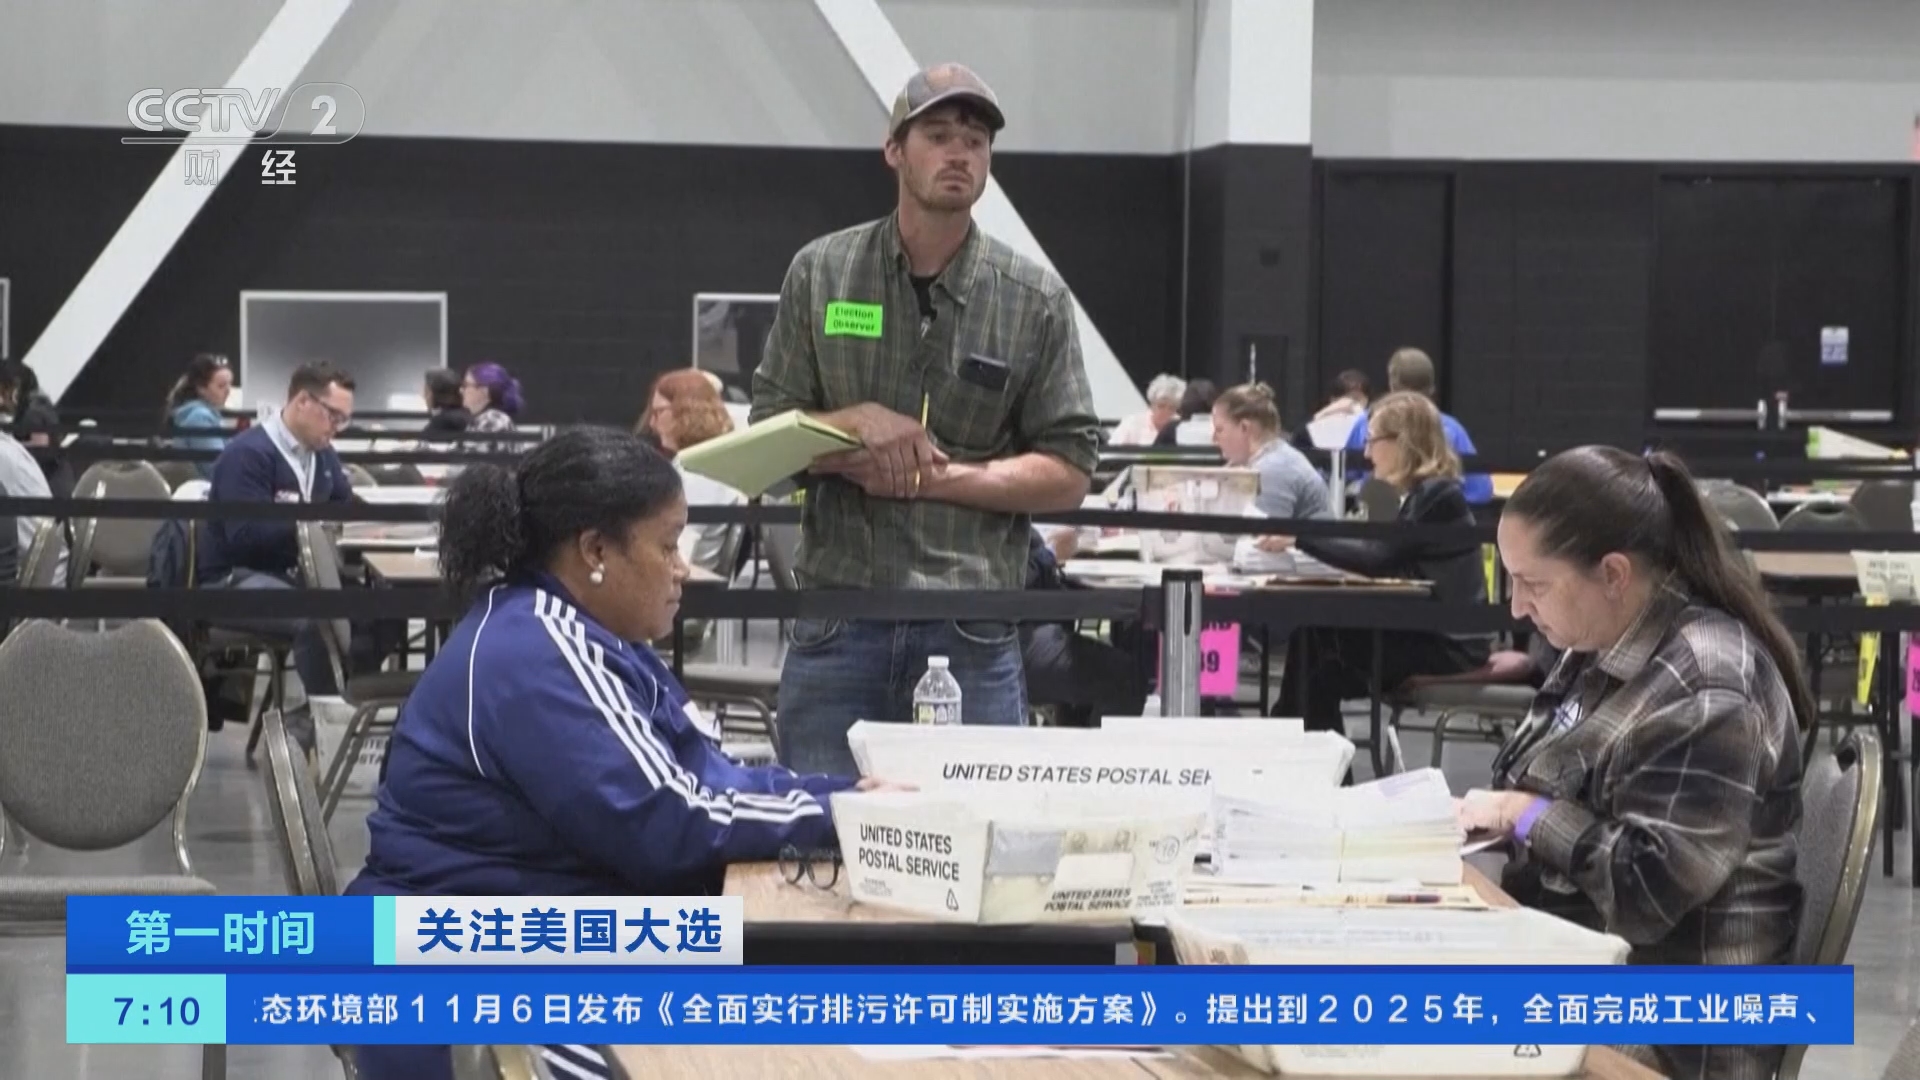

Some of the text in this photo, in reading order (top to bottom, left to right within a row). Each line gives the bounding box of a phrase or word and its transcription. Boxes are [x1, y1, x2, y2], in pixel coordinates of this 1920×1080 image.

[835, 306, 874, 319] Election
[833, 319, 875, 331] Observer
[942, 763, 1012, 782] UNITED
[1017, 765, 1092, 784] STATES
[1096, 767, 1172, 786] POSTAL
[859, 822, 953, 856] UNITED STATES
[858, 846, 960, 883] POSTAL SERVICE
